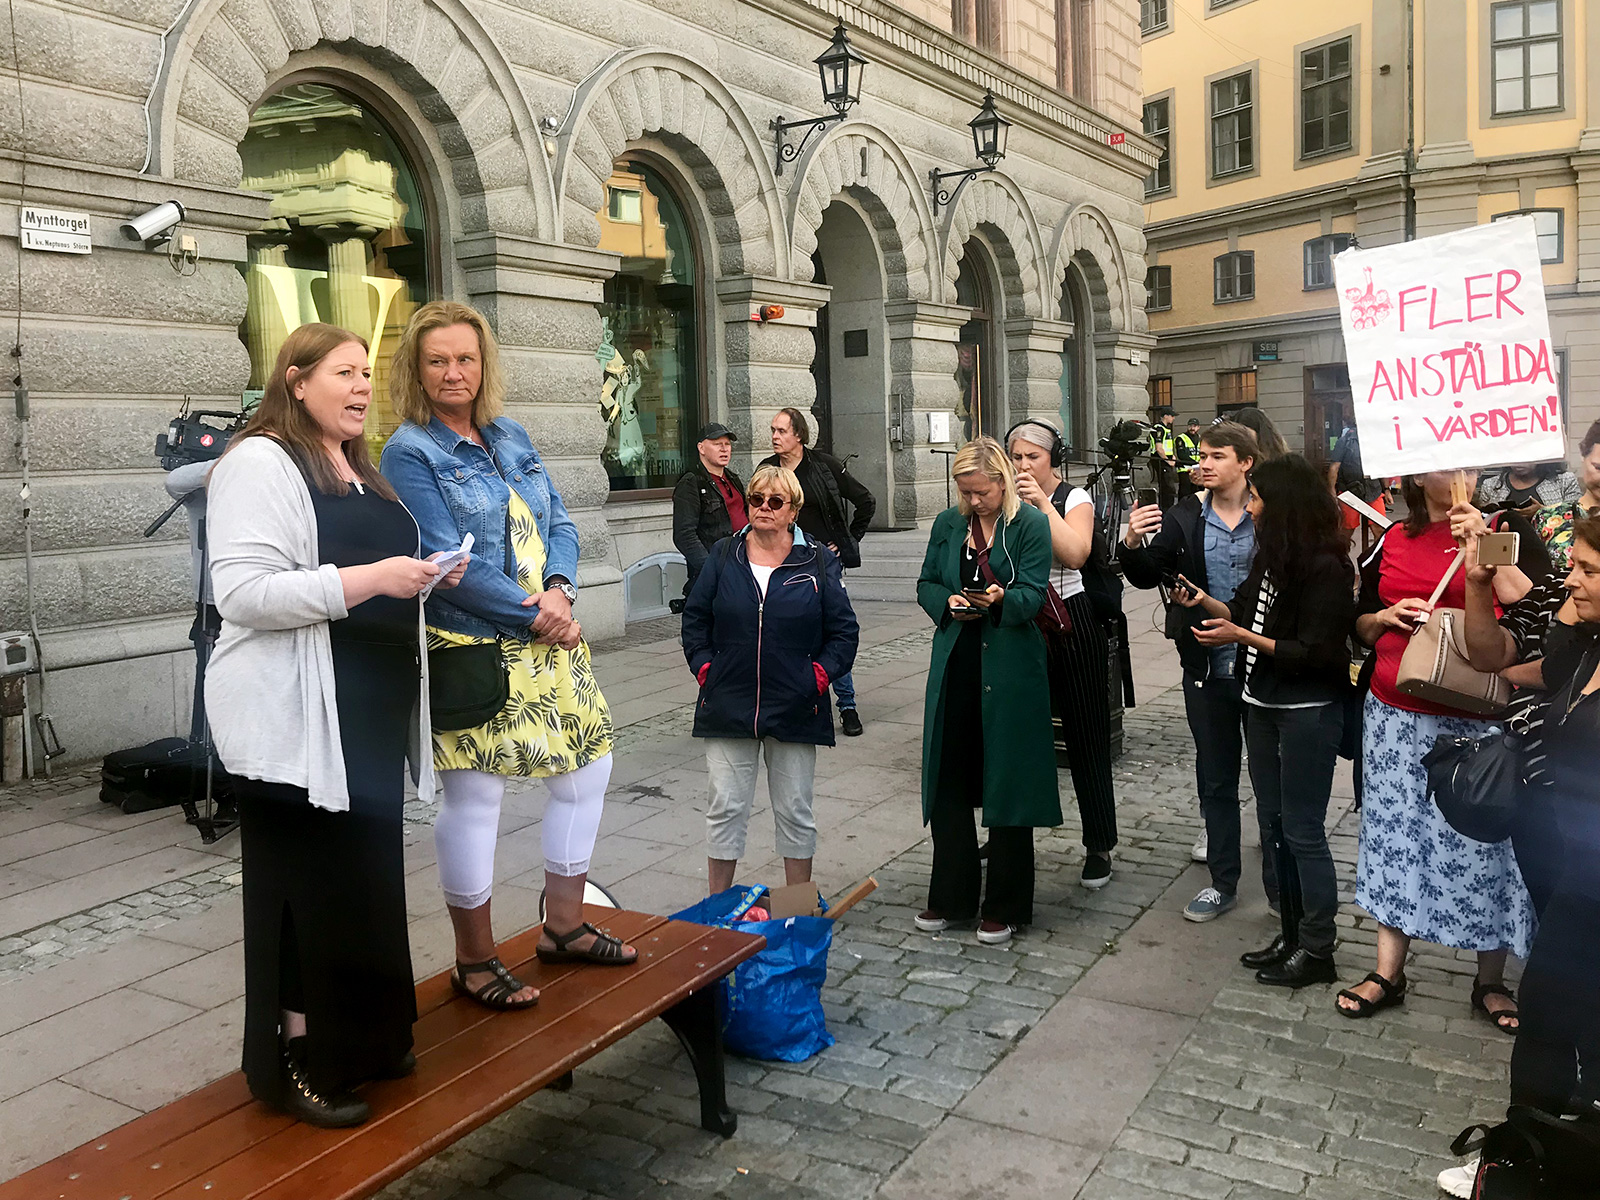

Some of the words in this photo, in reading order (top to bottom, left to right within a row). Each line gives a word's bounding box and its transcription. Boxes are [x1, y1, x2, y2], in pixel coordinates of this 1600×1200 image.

[25, 210, 88, 232] Mynttorget
[26, 232, 31, 244] 1
[1398, 268, 1525, 332] FLER
[1260, 343, 1277, 351] SEB
[1367, 338, 1555, 404] ANSTÄLLDA
[1422, 395, 1558, 442] VÅRDEN!
[733, 885, 763, 916] IKEA
